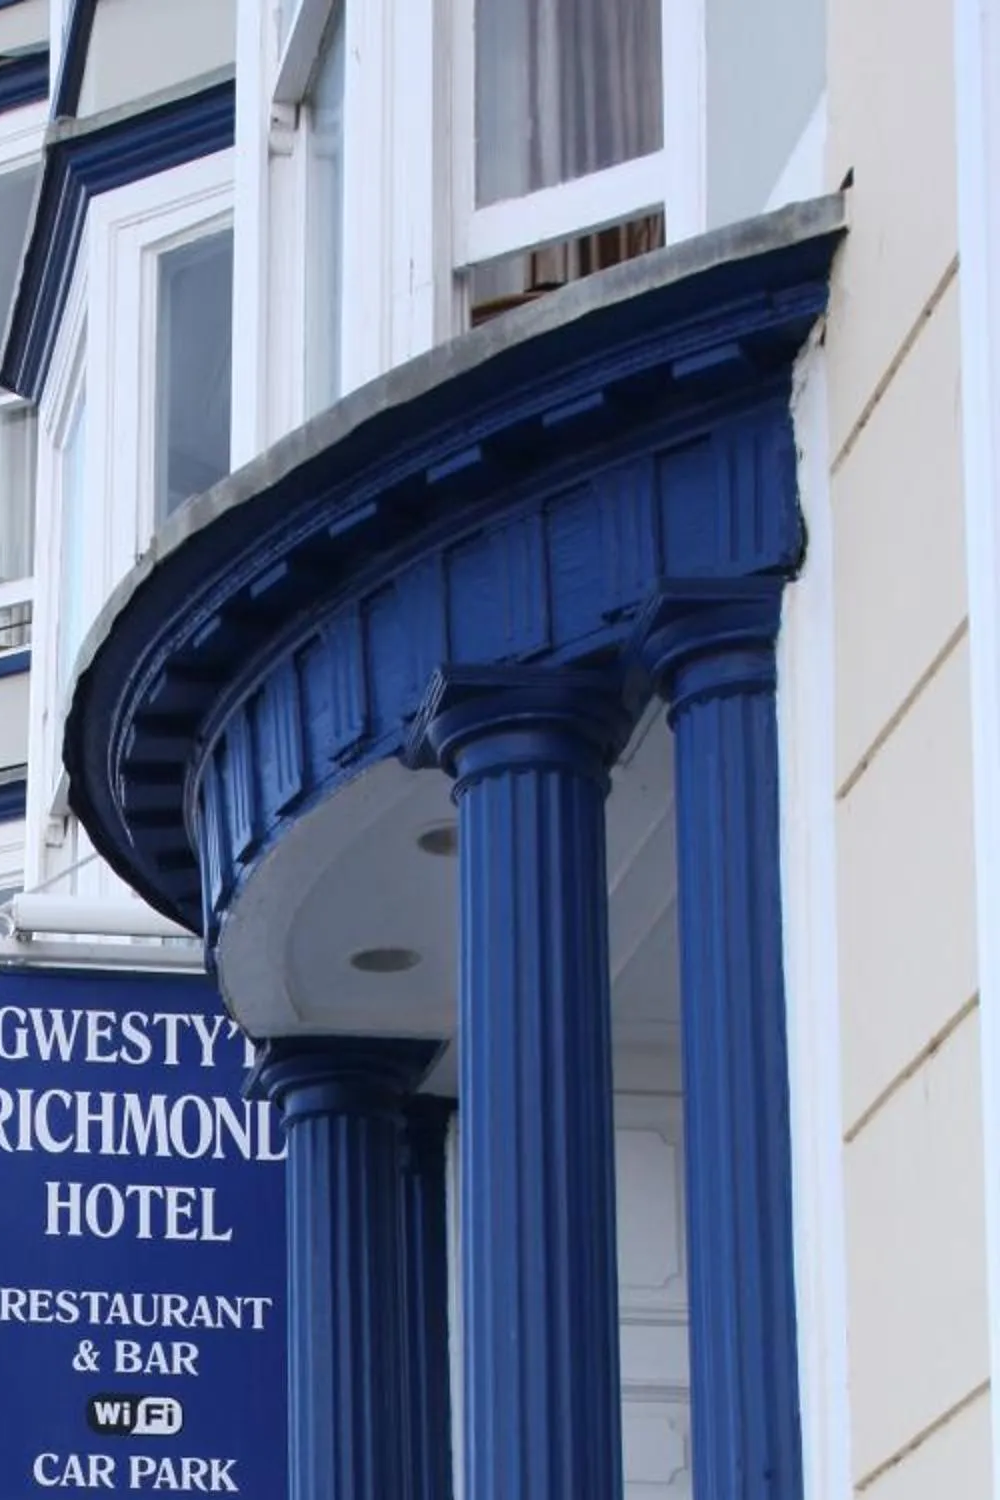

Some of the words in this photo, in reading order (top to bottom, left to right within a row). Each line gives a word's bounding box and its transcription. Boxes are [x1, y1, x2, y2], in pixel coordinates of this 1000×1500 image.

[45, 1181, 233, 1241] HOTEL
[0, 1287, 273, 1329] RESTAURANT
[72, 1339, 100, 1372] &
[115, 1340, 199, 1376] BAR
[33, 1453, 115, 1490] CAR
[129, 1455, 239, 1492] PARK
